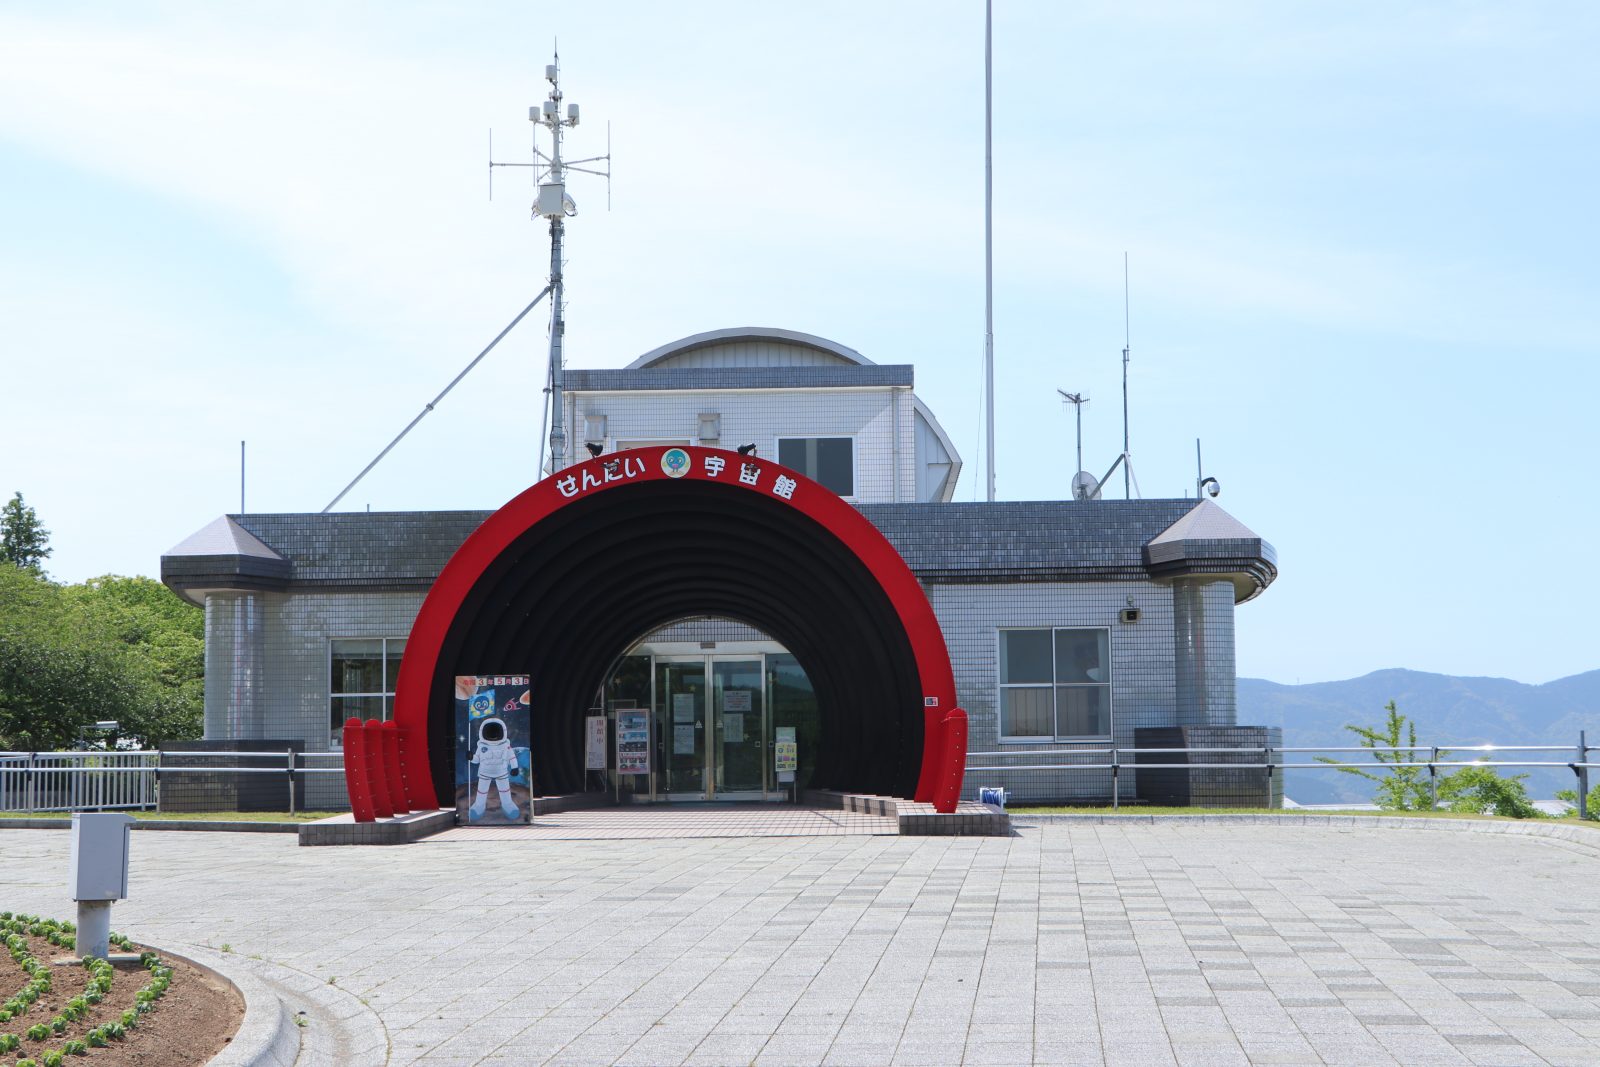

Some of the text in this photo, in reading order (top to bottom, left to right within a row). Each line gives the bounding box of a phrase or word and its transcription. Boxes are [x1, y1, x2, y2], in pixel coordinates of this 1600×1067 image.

[556, 456, 797, 499] せんだい 宇宙館
